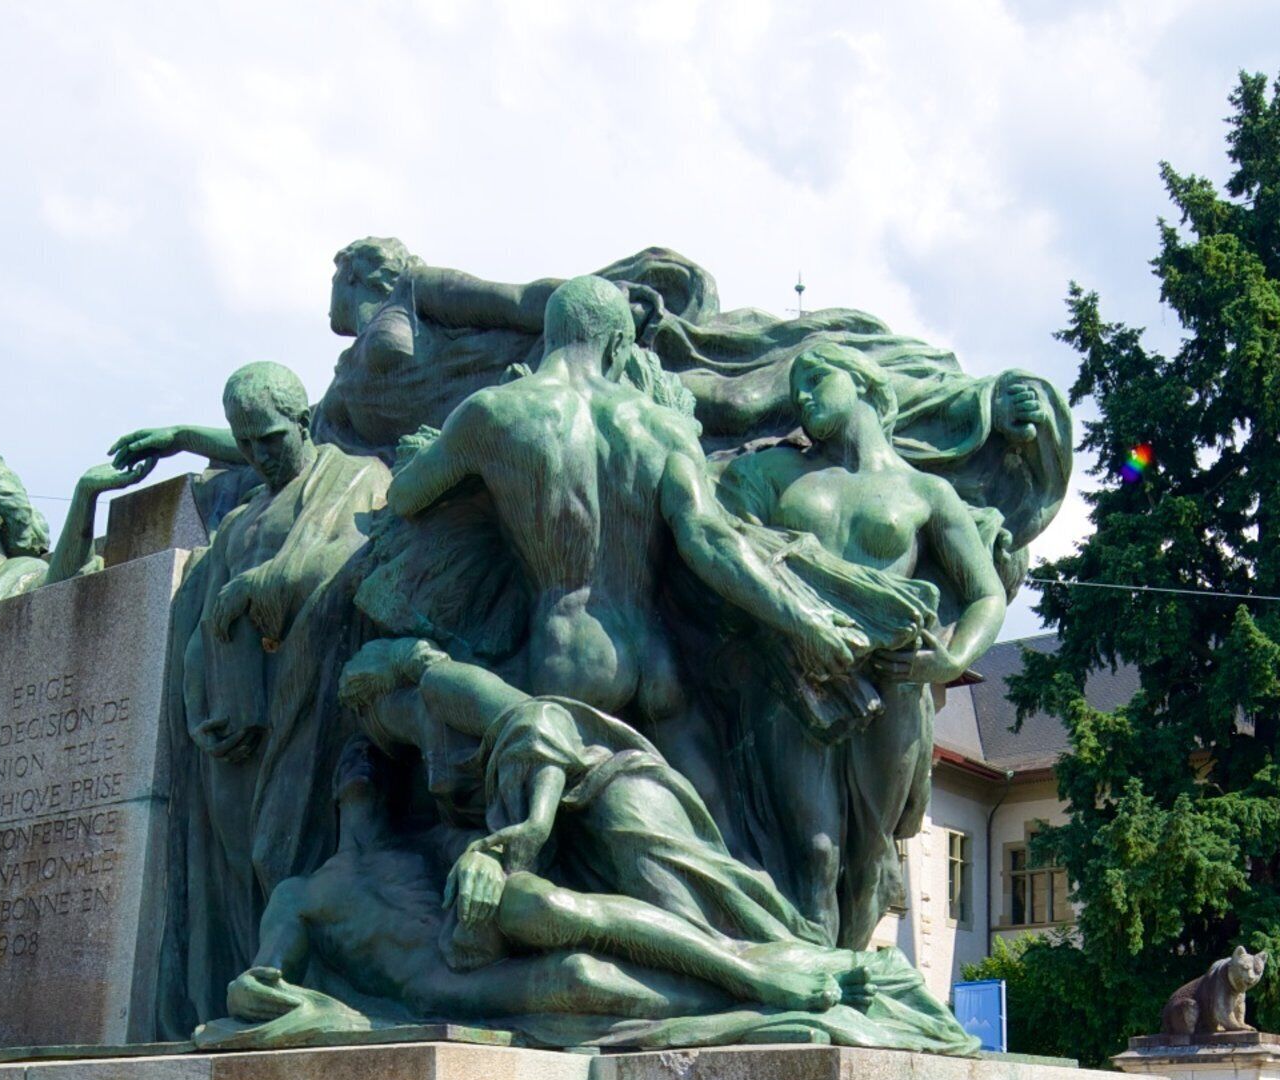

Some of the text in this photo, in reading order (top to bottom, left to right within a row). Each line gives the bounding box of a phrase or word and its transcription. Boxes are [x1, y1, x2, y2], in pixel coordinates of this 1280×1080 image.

[0, 705, 96, 747] DECISION
[102, 697, 130, 725] DE
[70, 773, 123, 805] PRISE
[82, 886, 111, 912] EN
